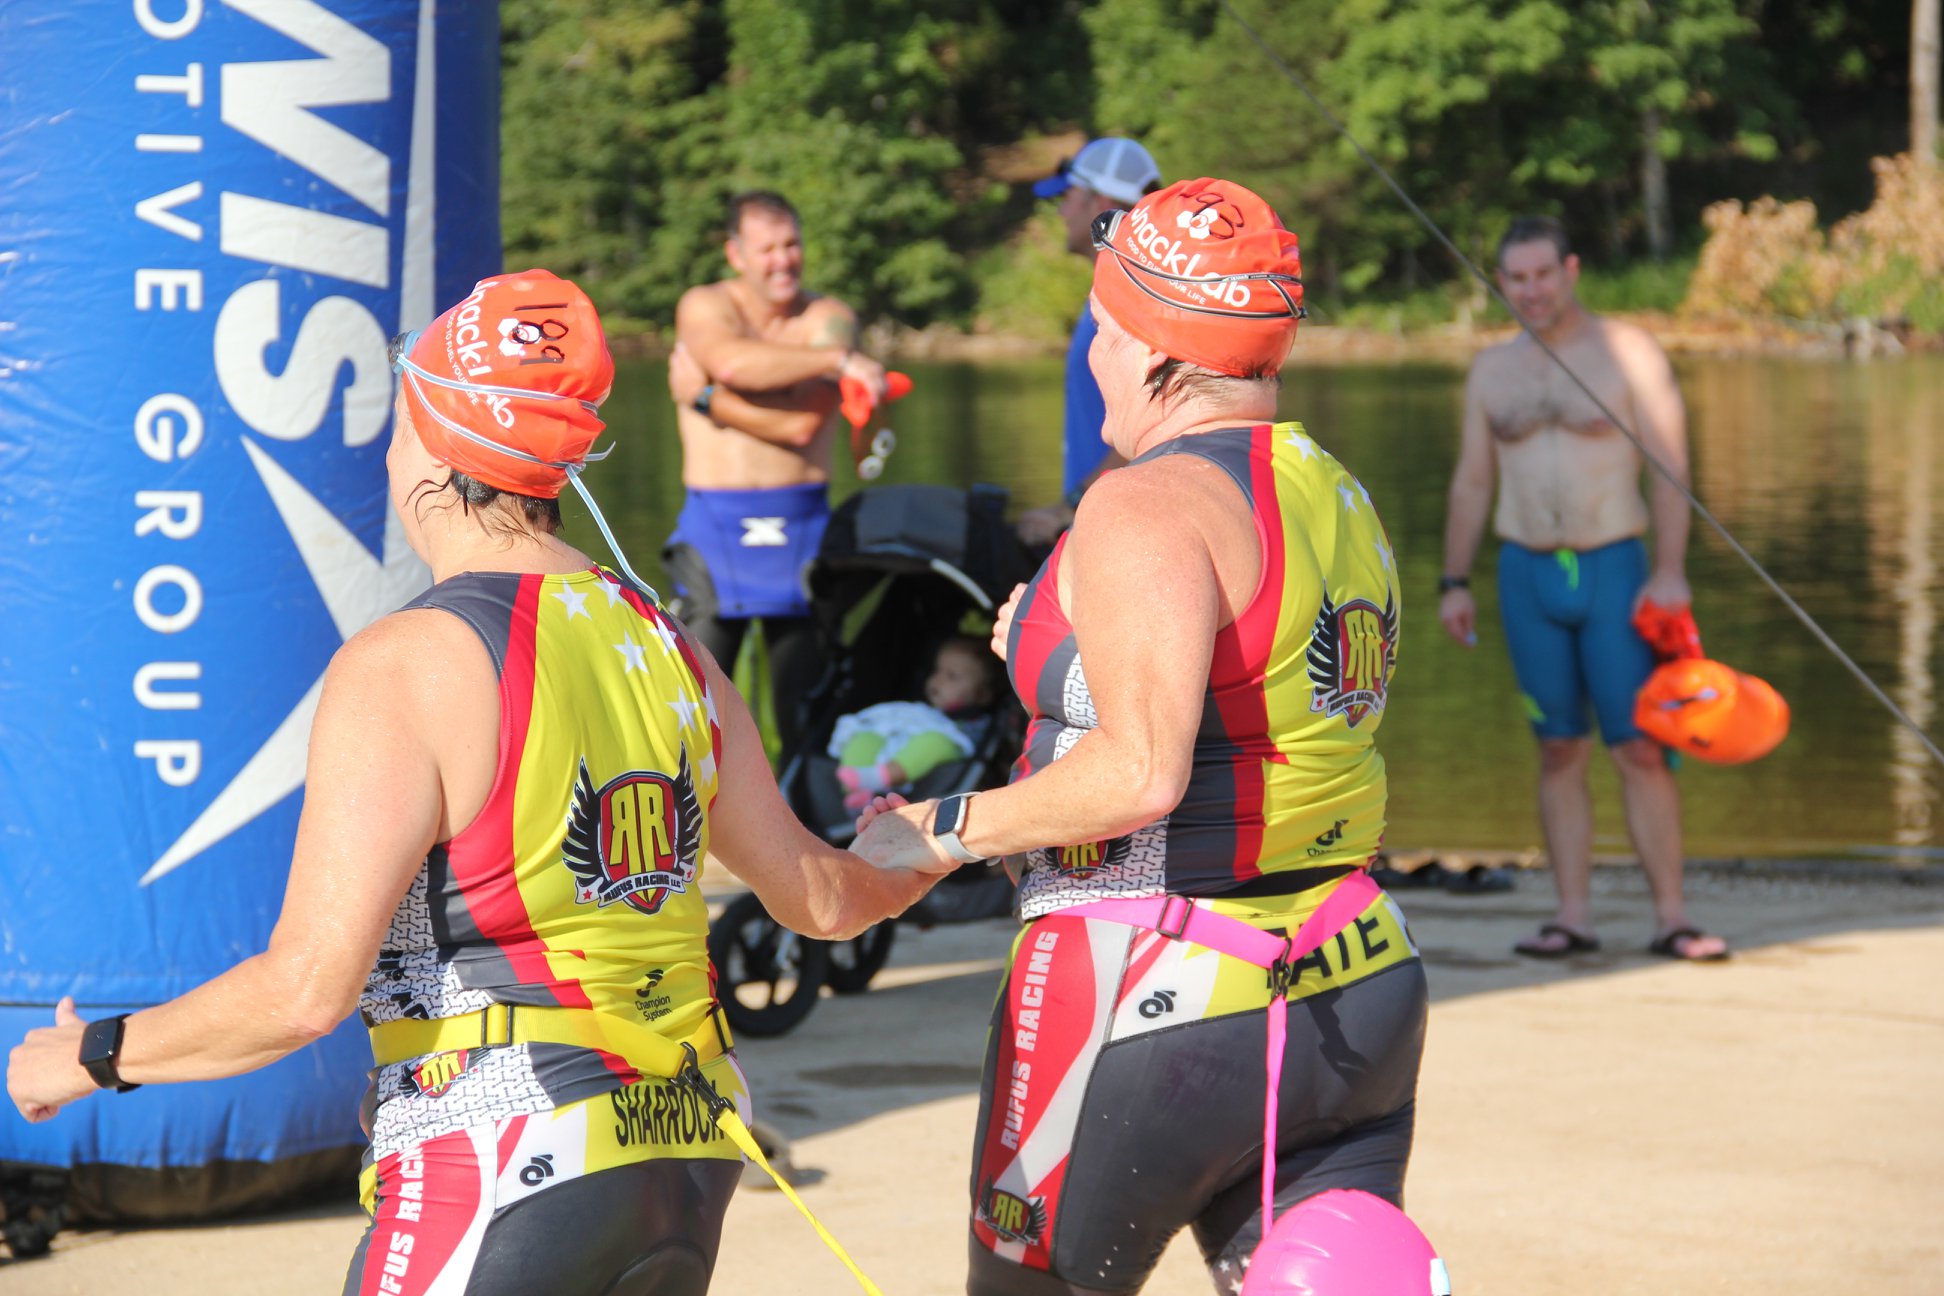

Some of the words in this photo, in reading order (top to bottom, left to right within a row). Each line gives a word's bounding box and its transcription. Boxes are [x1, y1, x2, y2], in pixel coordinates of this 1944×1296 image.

[1138, 252, 1148, 263] TO
[1187, 290, 1207, 305] LIFE
[446, 341, 455, 363] FUEL
[512, 302, 569, 366] 189
[133, 392, 204, 788] GROUP
[635, 874, 670, 888] RACING
[671, 878, 682, 889] LLC
[635, 995, 671, 1011] Champion
[642, 1007, 673, 1022] System
[1015, 931, 1060, 1052] RACING
[1001, 1059, 1032, 1151] RUFUS
